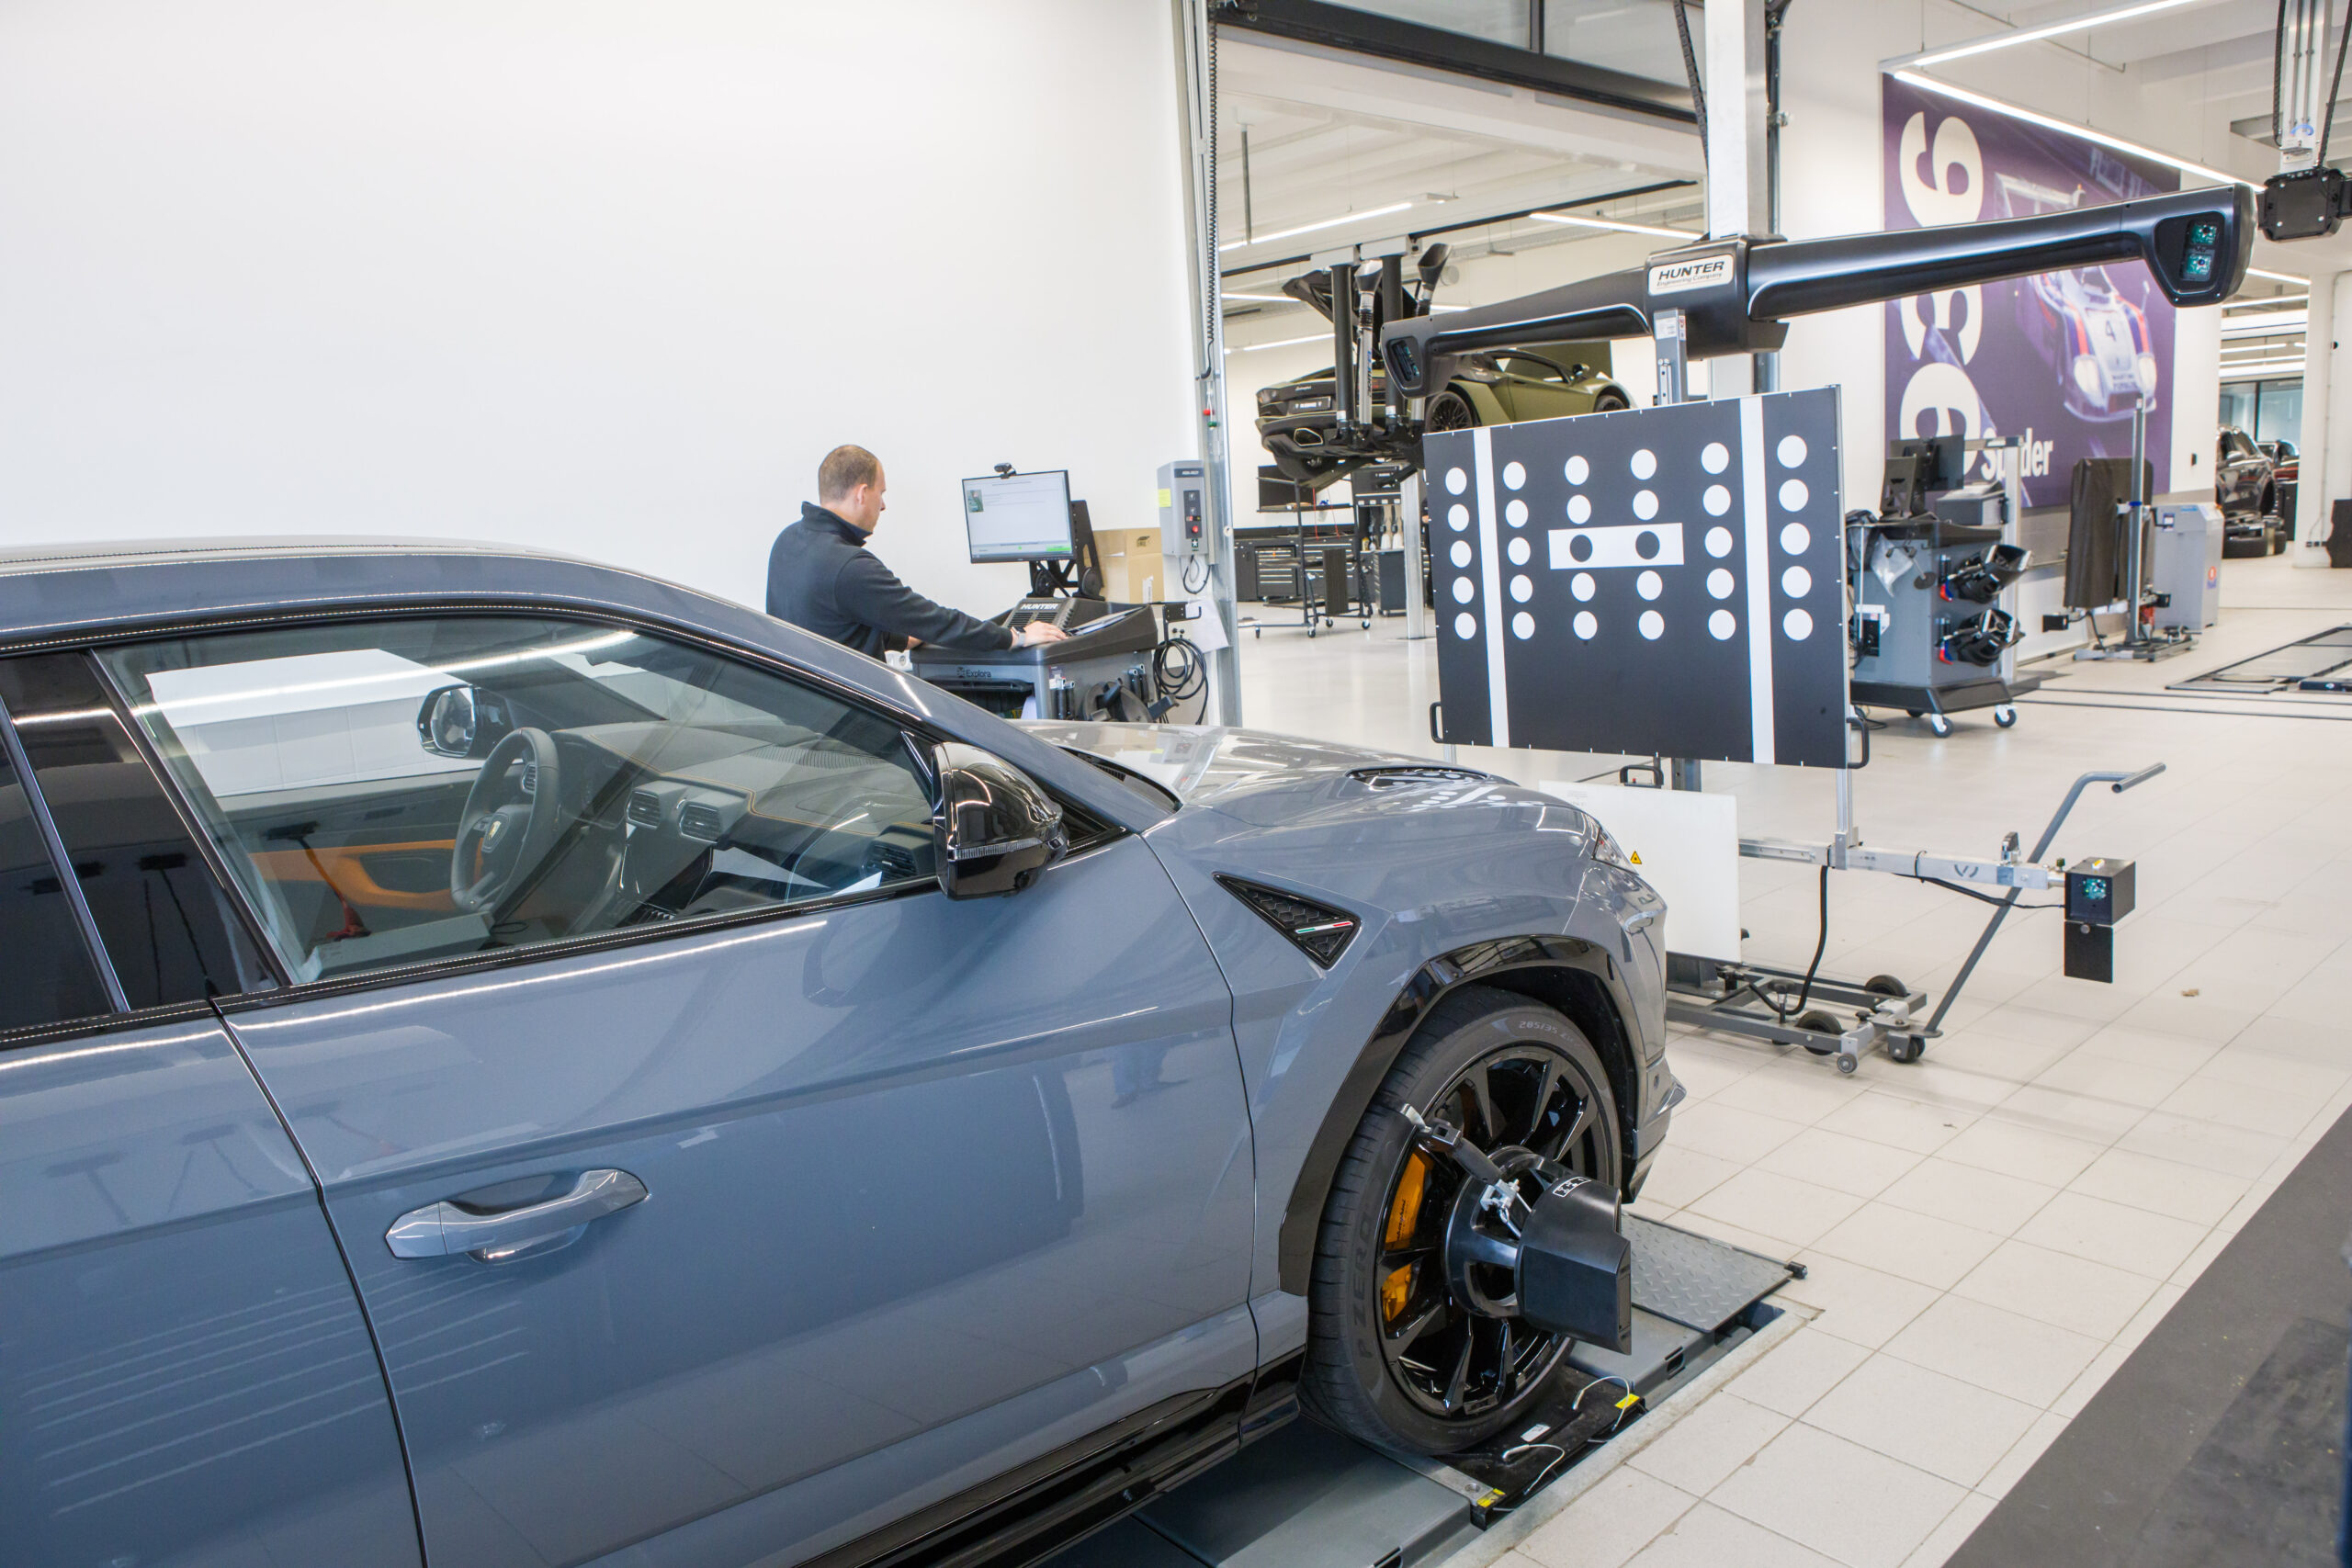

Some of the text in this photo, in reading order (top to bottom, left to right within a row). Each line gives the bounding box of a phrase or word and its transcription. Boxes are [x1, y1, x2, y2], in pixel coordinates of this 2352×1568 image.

[1658, 261, 1724, 281] HUNTER
[1693, 272, 1723, 282] Company
[2105, 320, 2117, 342] 4
[1981, 427, 2053, 480] Spder
[966, 669, 991, 678] Explora
[1519, 1021, 1558, 1034] 285/35
[1353, 1210, 1372, 1328] ZERO
